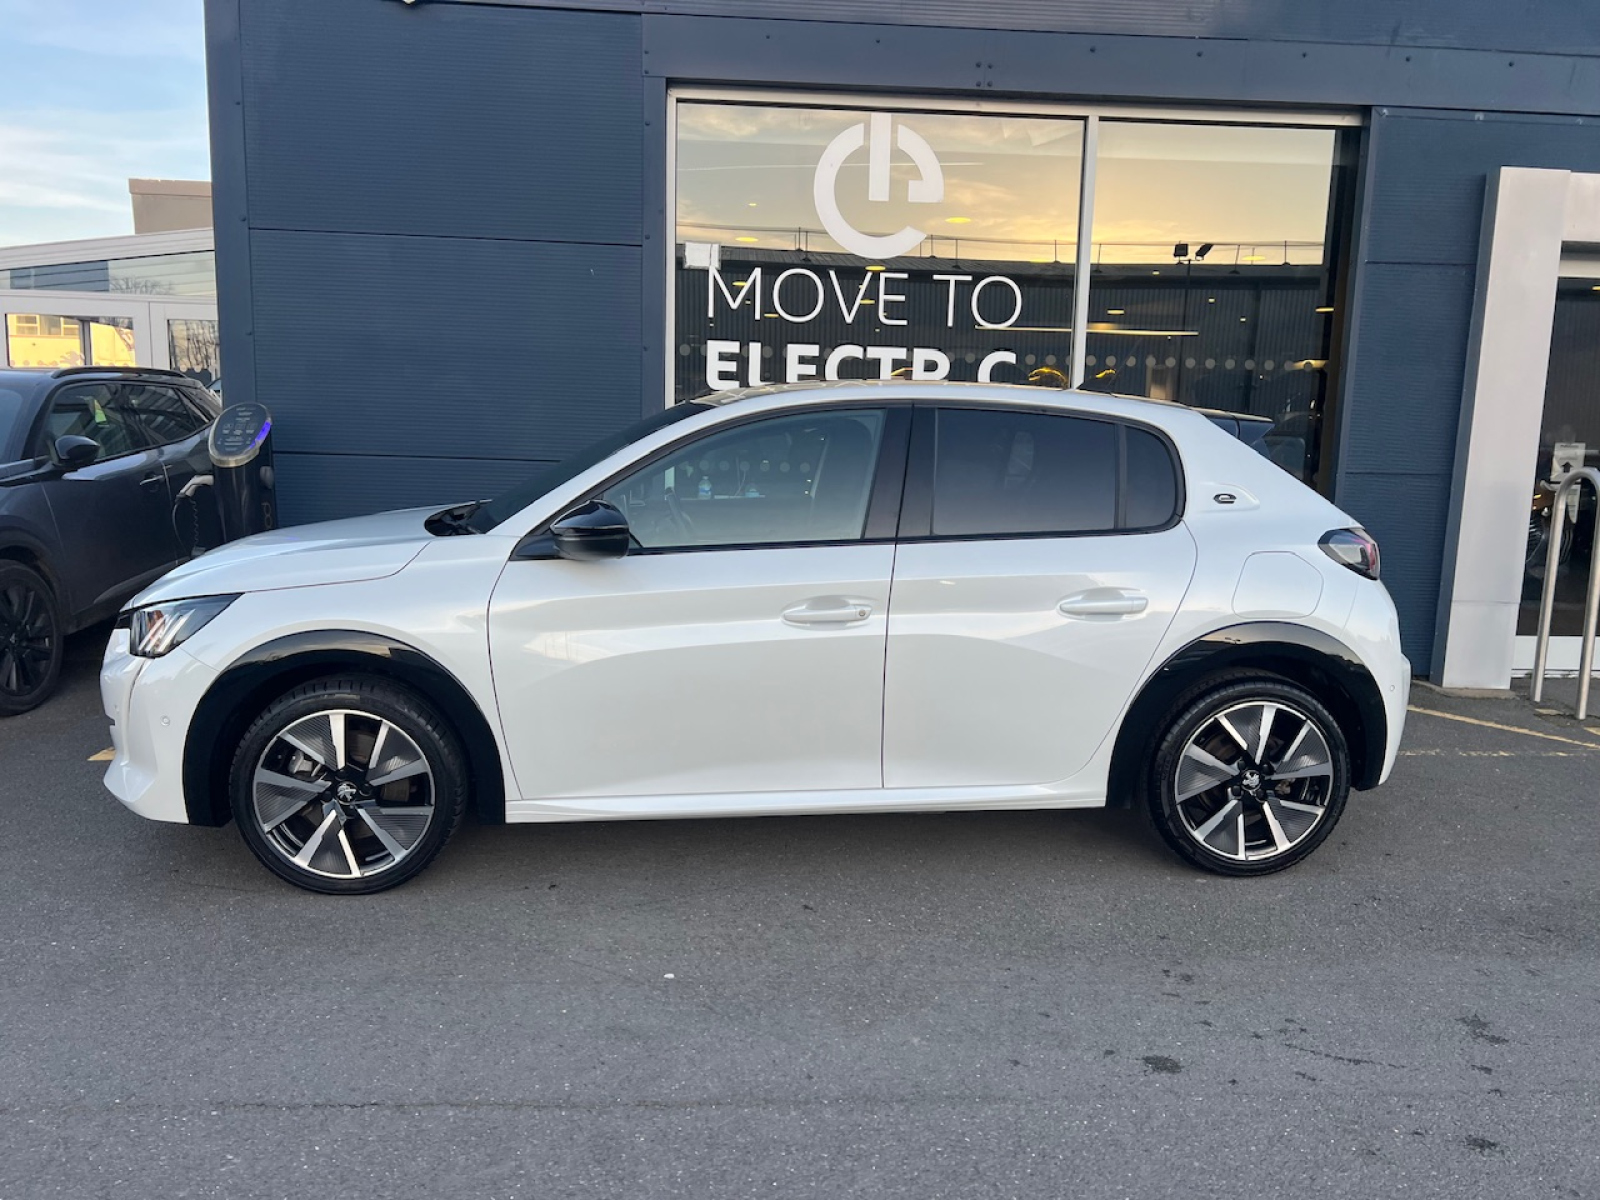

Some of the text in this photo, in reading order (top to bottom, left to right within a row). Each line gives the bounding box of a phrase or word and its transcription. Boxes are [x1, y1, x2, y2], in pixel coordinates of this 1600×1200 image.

[708, 266, 1022, 329] MOVE TO
[706, 340, 1017, 391] ELECTRC
